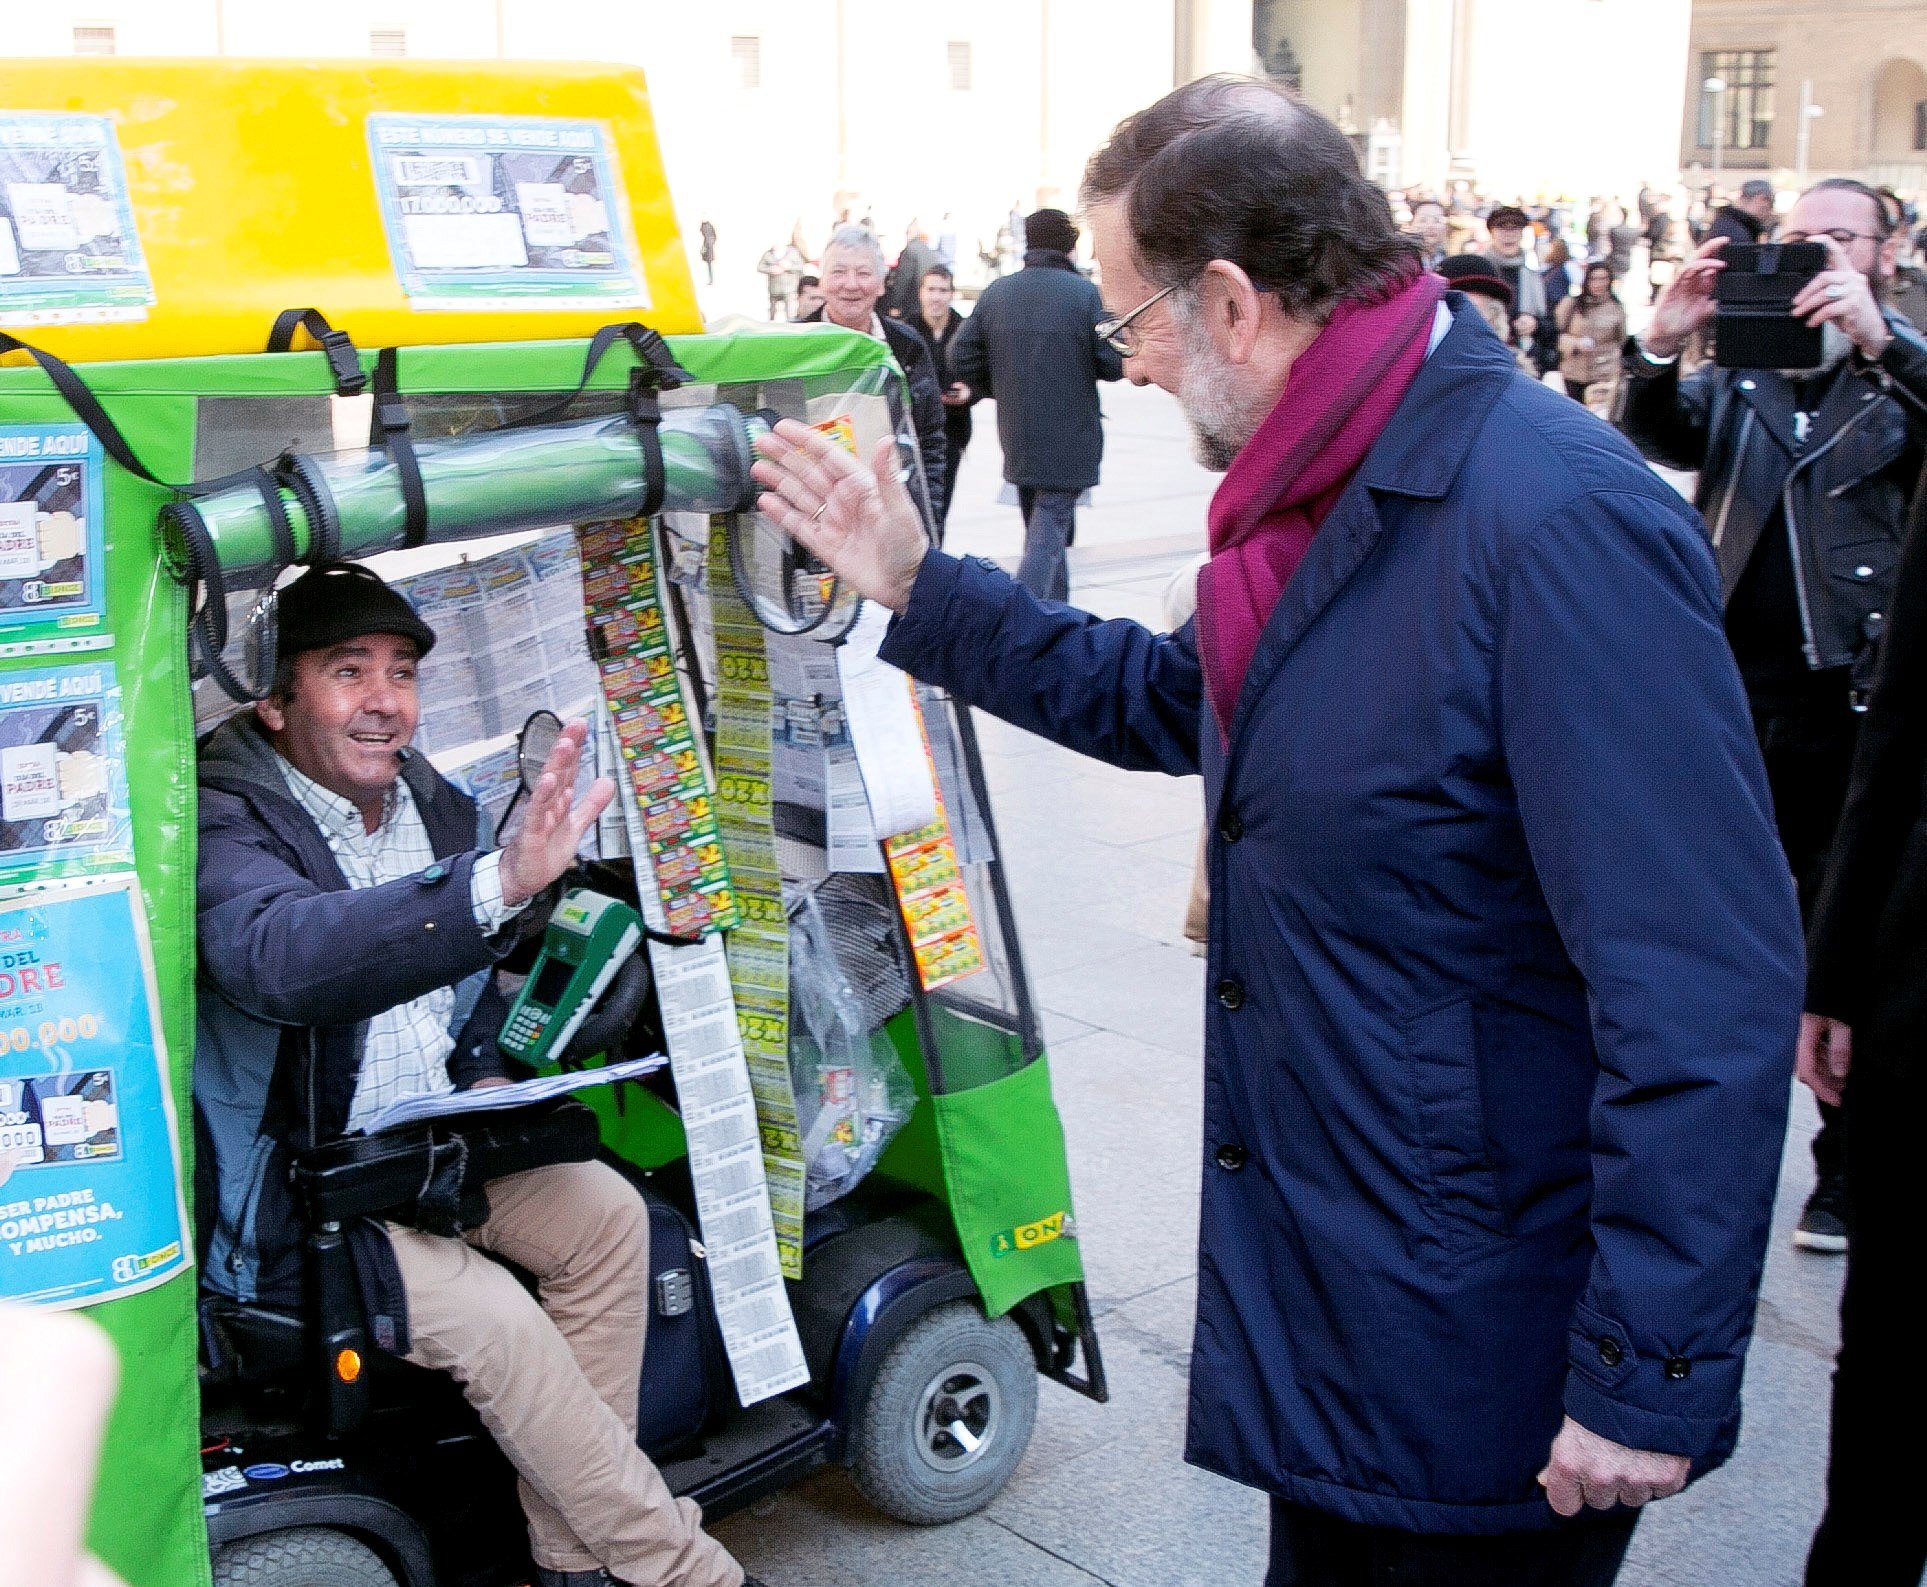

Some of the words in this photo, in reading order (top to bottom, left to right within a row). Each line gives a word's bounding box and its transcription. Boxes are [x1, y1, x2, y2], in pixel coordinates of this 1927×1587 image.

[42, 430, 88, 456] AQUÍ
[2, 950, 40, 969] DEL
[0, 1201, 32, 1220] SER
[33, 1188, 96, 1213] PADRE
[0, 1202, 124, 1240] OMPENSA,
[9, 1242, 24, 1256] Y
[26, 1228, 103, 1254] MUCHO.
[290, 1458, 345, 1473] Comet
